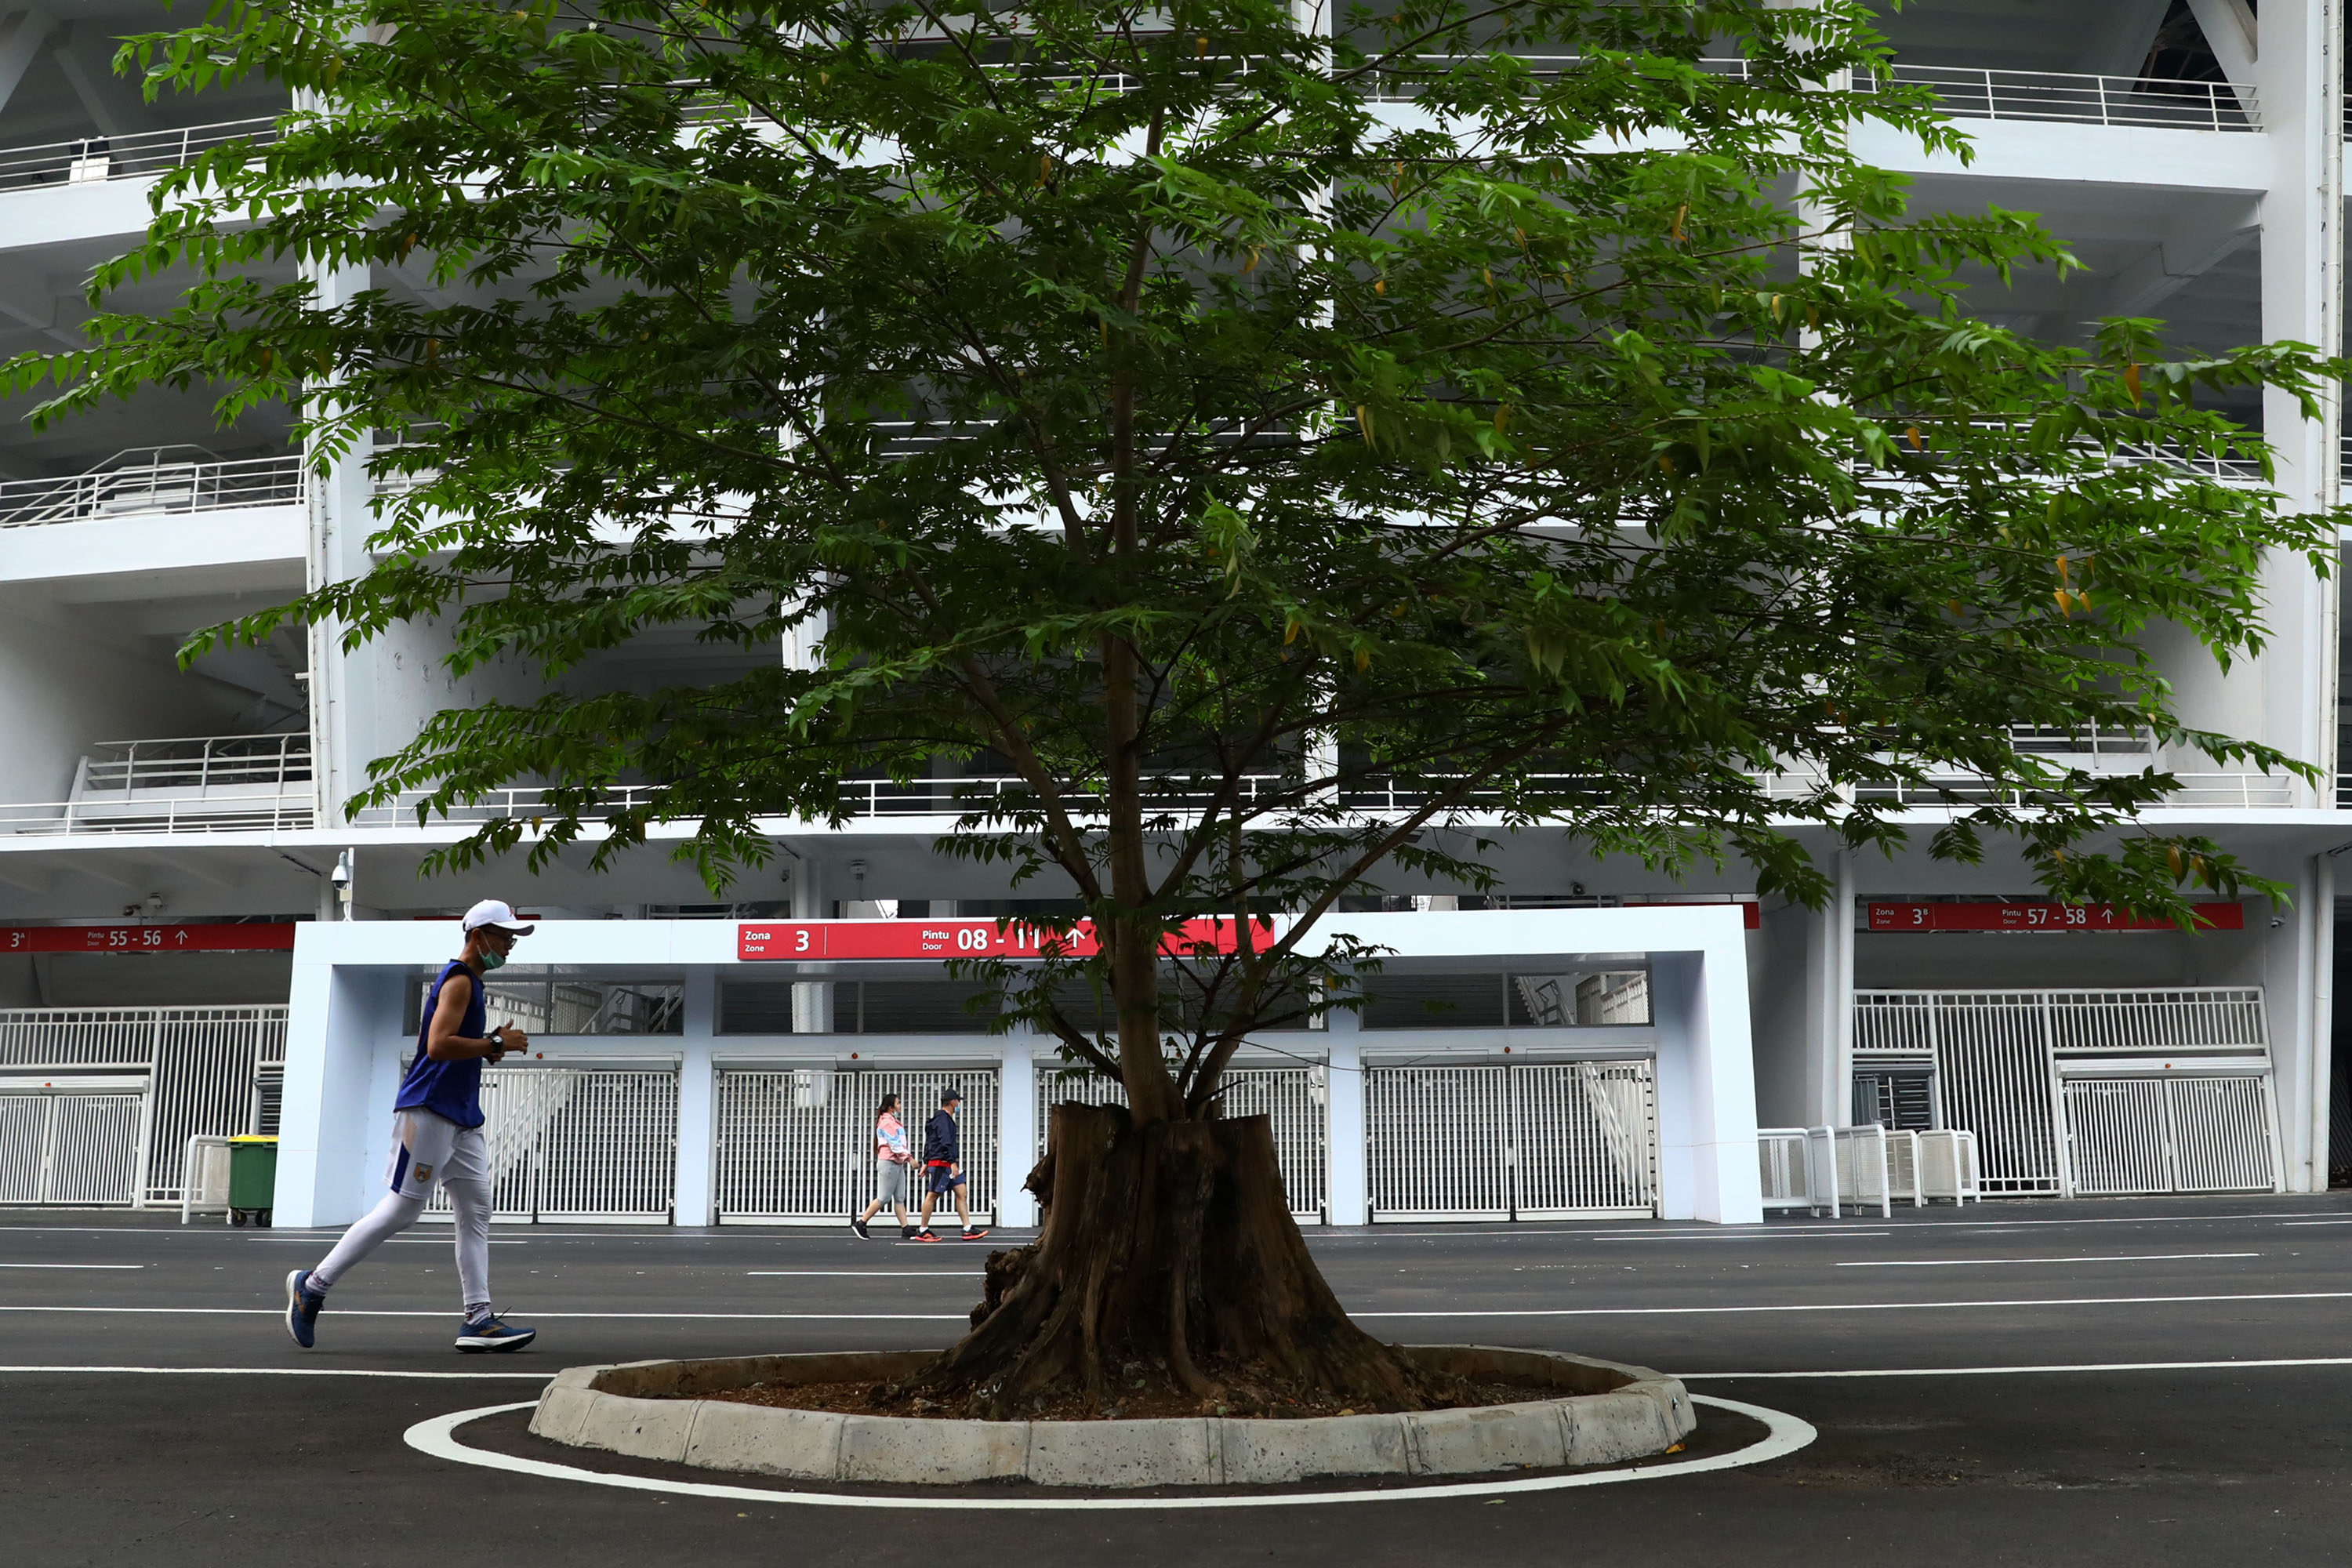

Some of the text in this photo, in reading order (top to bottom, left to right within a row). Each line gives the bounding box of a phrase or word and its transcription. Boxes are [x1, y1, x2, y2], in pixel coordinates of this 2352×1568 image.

[2027, 909, 2048, 924] 57
[2066, 908, 2086, 924] 58
[109, 931, 128, 946] 55
[143, 930, 162, 946] 56
[745, 931, 771, 941] Zona
[795, 930, 810, 952] 3
[922, 931, 949, 939] Pintu
[957, 928, 988, 950] 08
